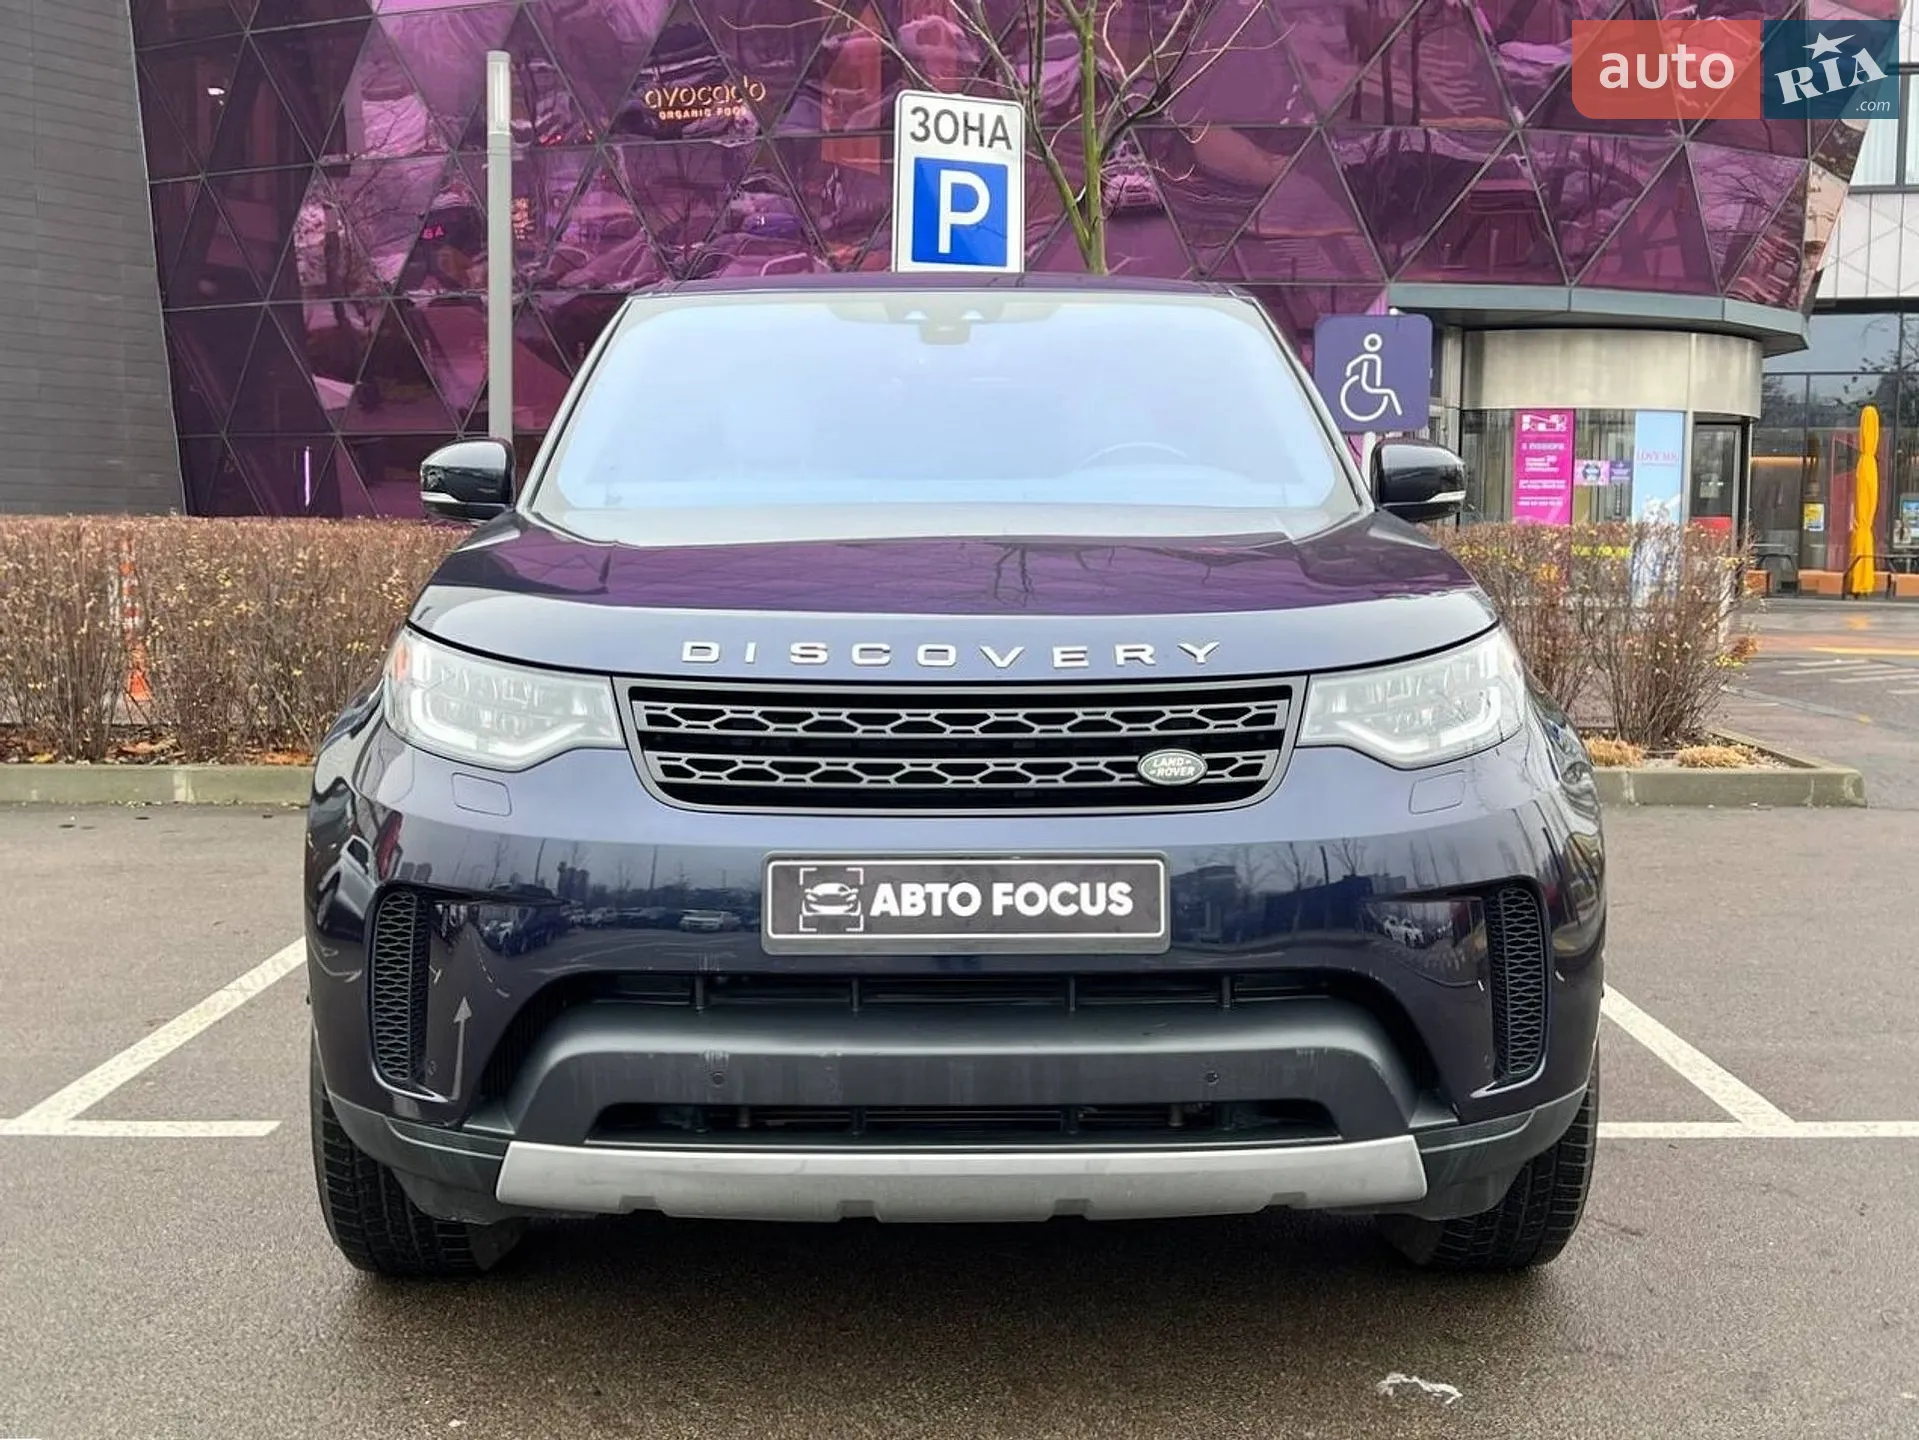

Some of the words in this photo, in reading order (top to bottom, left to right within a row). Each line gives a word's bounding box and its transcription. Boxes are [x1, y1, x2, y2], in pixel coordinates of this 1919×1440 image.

[644, 74, 766, 109] avocado
[659, 107, 712, 121] ORGANIC
[909, 105, 1013, 151] ЗОНА
[938, 169, 991, 254] P
[681, 641, 1220, 668] DISCOVERY
[1153, 757, 1185, 768] LAND
[1157, 766, 1195, 777] ROVER
[869, 881, 982, 917] АВТО
[992, 881, 1134, 917] FOCUS
